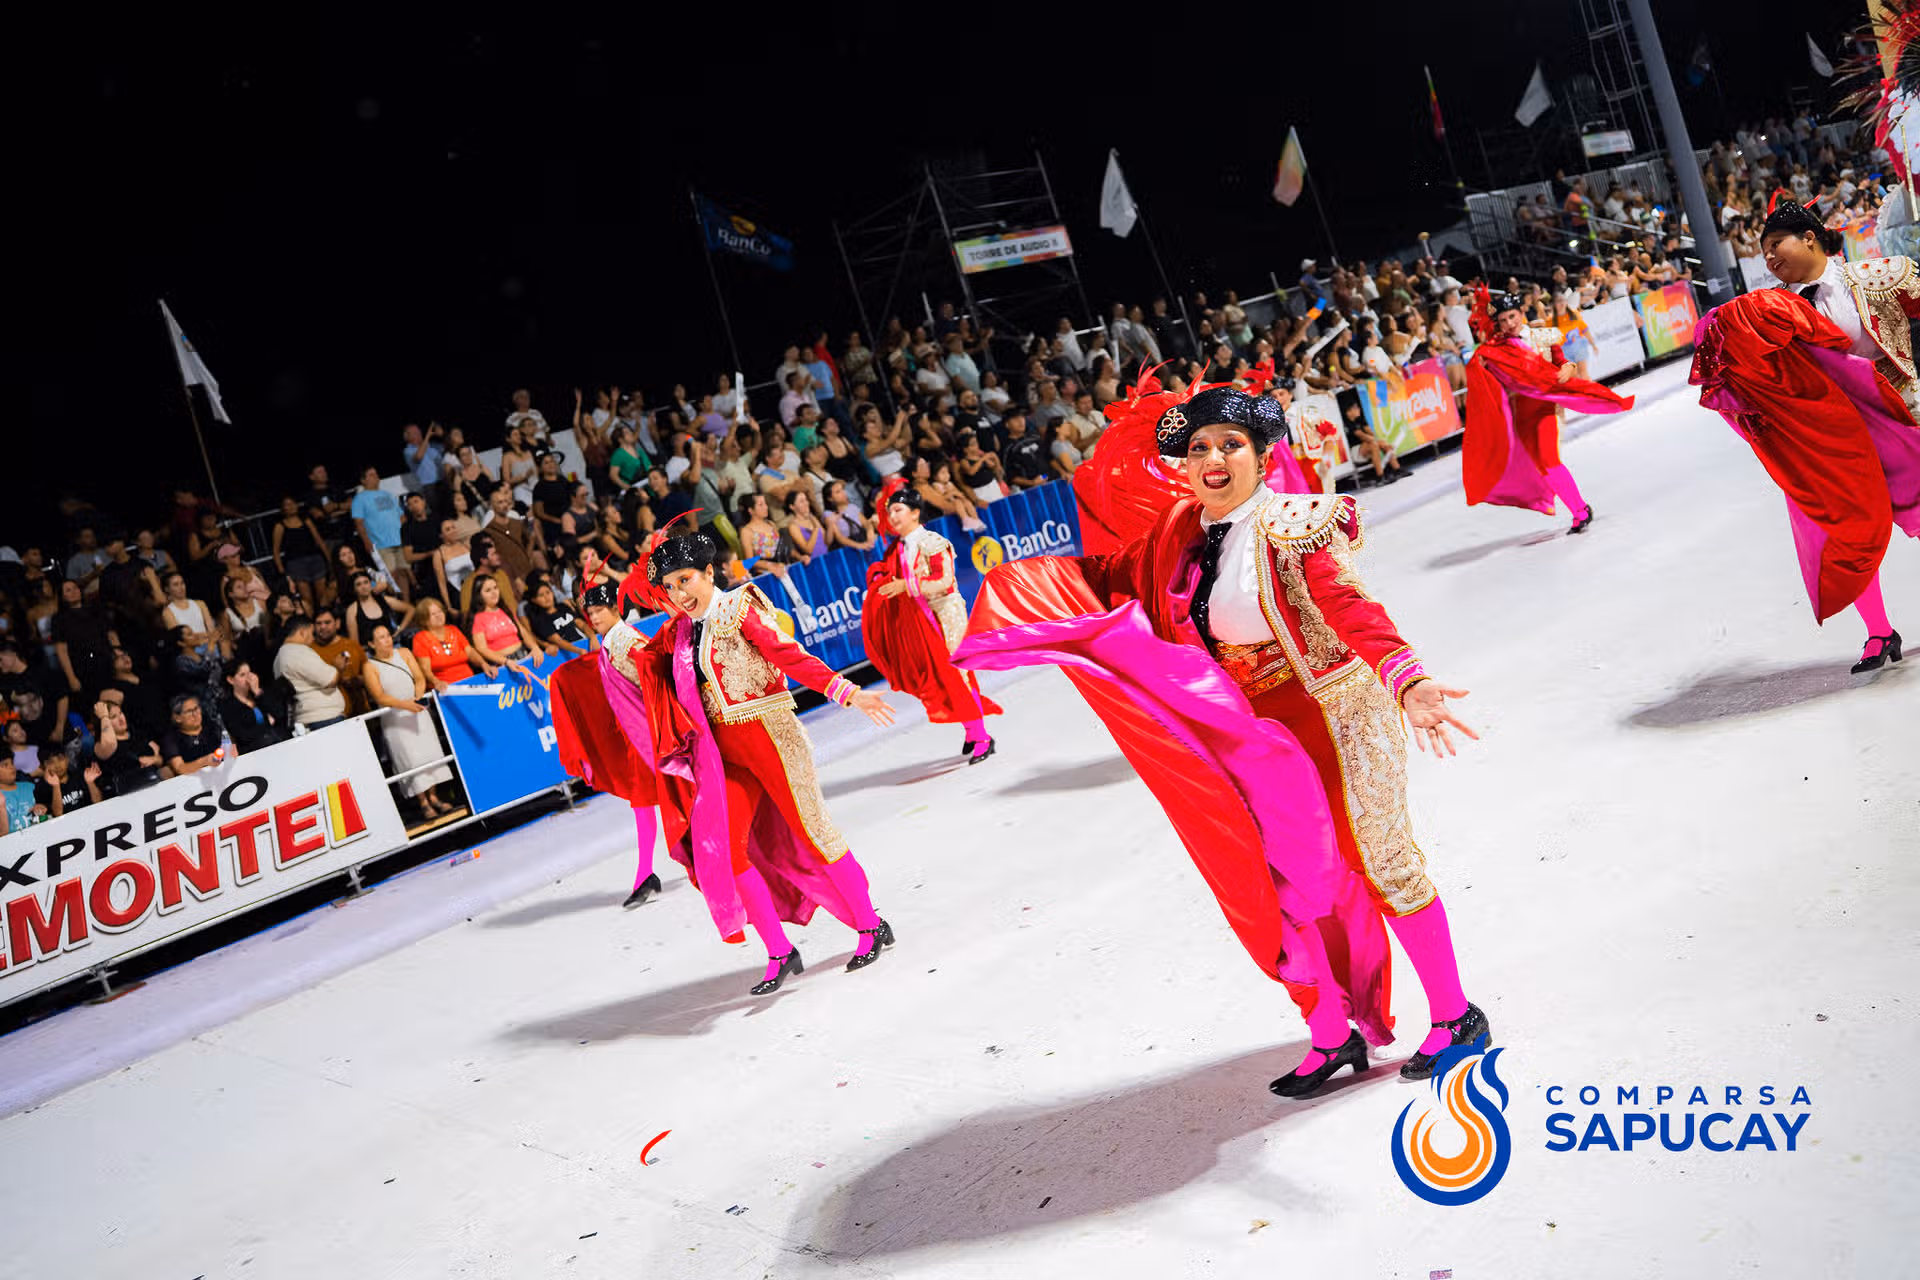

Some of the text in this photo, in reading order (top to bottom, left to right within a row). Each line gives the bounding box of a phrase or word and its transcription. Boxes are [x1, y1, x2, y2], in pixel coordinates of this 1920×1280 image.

[718, 228, 771, 255] BanCo
[1004, 244, 1019, 256] DE
[1021, 239, 1051, 252] AUDIO
[1000, 520, 1071, 561] BanCo
[0, 790, 326, 971] MONTE
